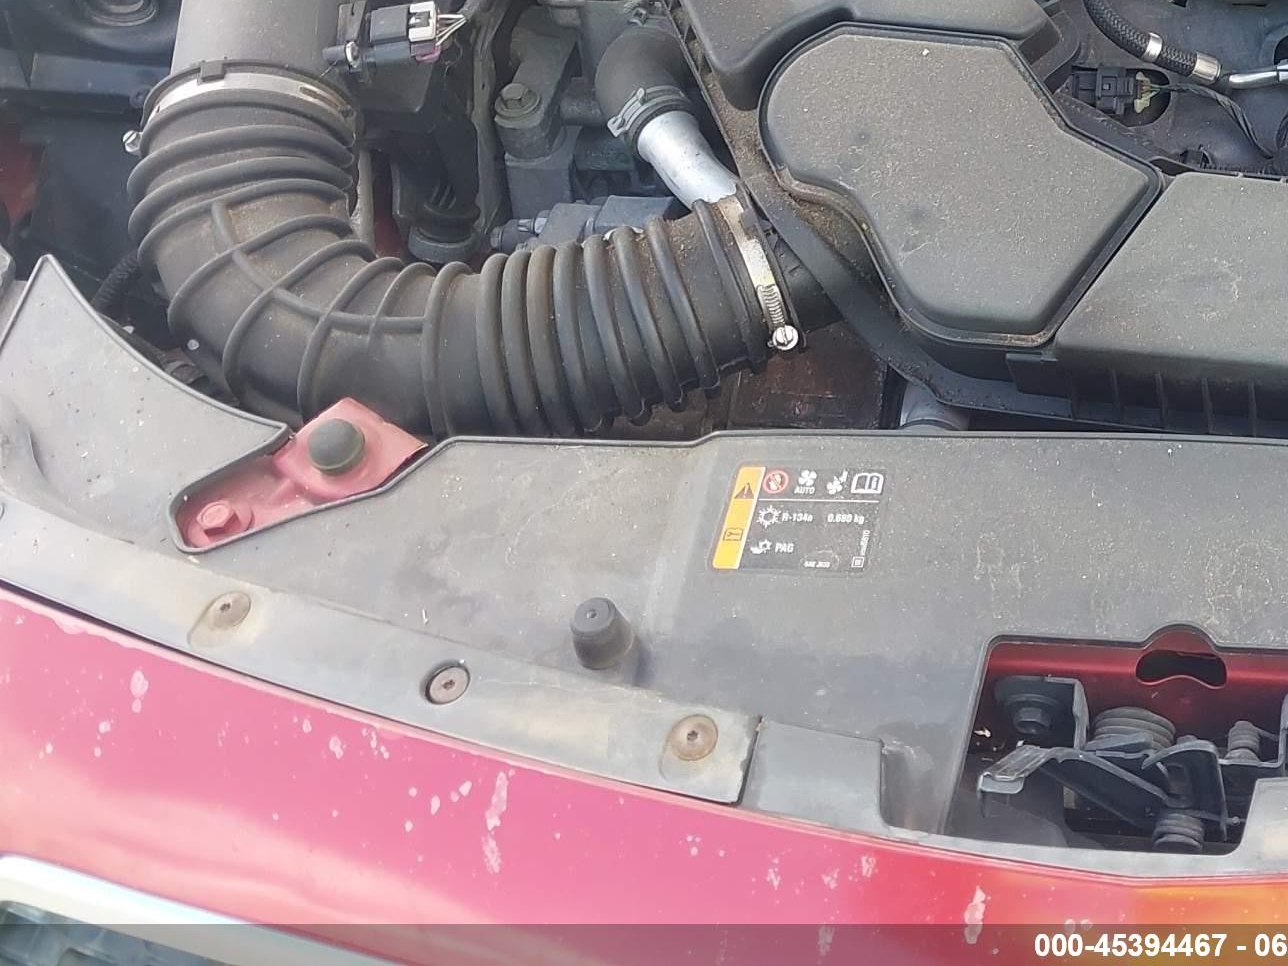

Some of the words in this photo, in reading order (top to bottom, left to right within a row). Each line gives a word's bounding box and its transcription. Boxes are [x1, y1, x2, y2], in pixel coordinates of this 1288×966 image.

[794, 486, 815, 494] AUTO
[781, 513, 813, 522] R-134a
[853, 514, 865, 525] kg
[774, 542, 794, 553] PAG
